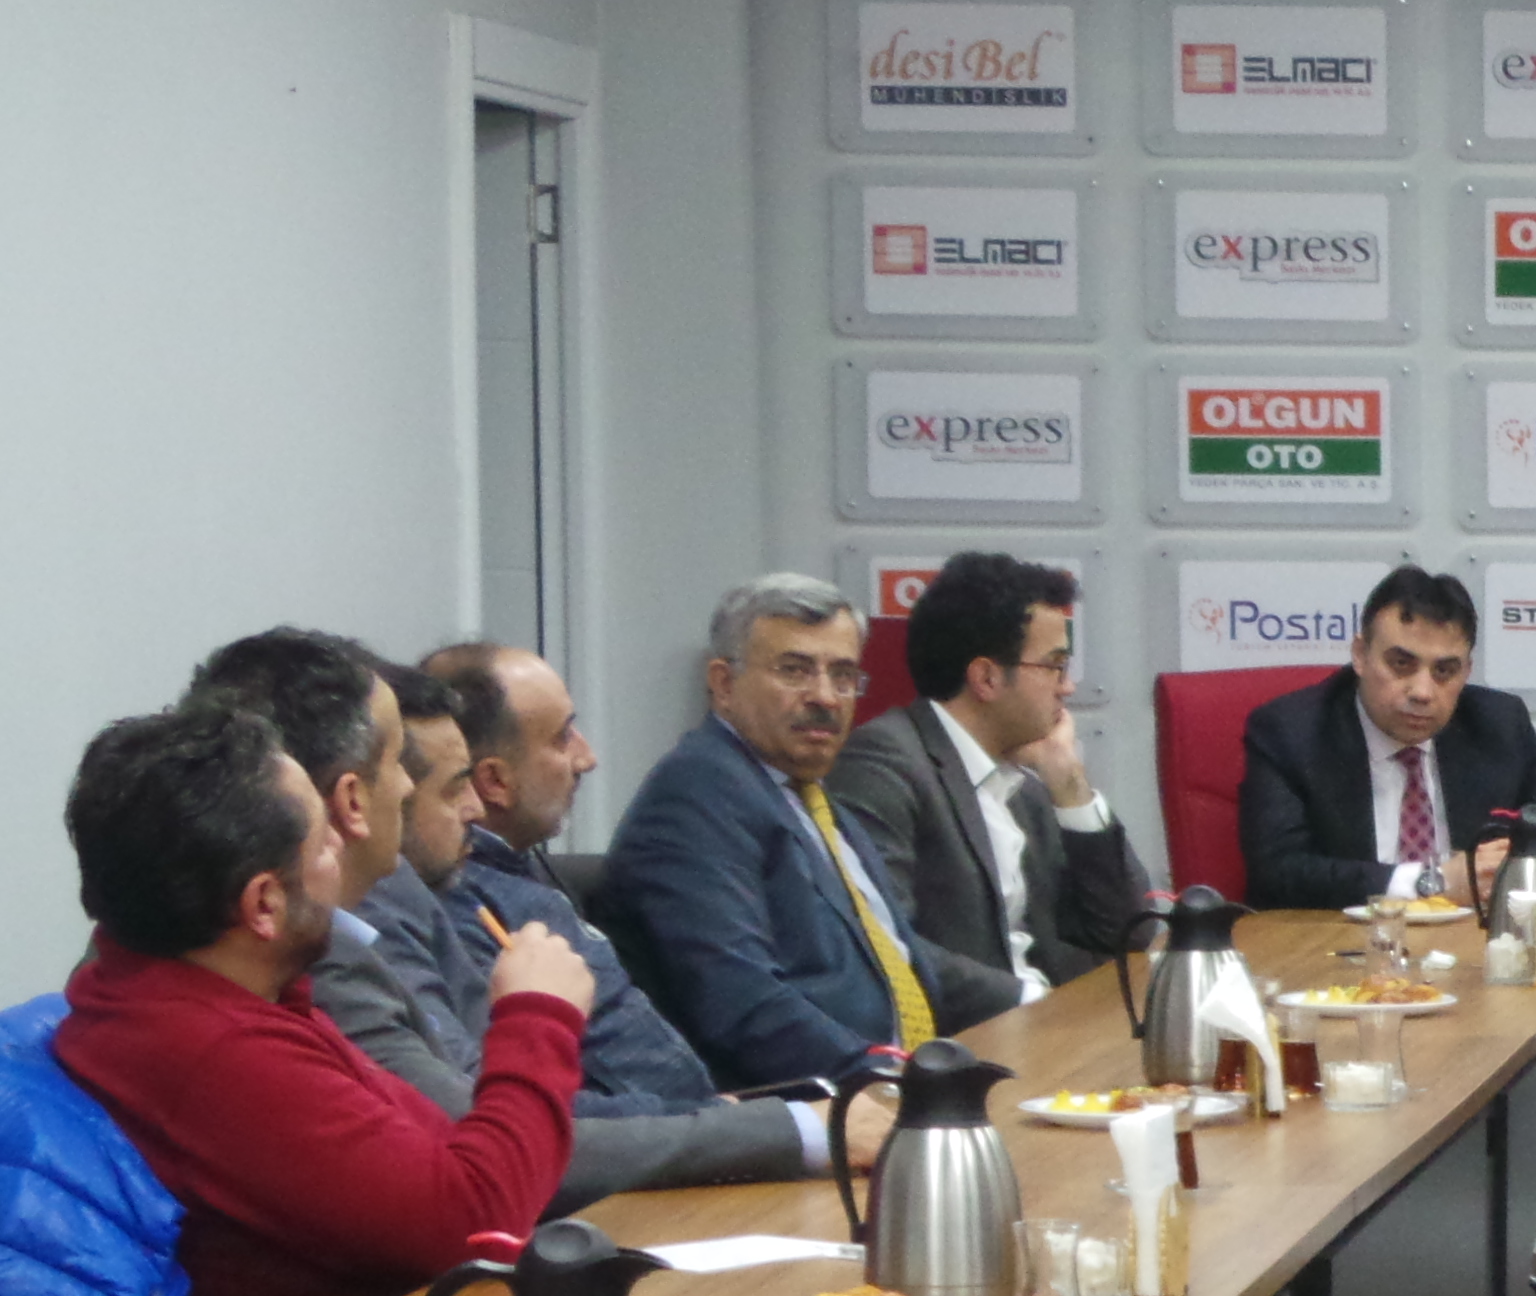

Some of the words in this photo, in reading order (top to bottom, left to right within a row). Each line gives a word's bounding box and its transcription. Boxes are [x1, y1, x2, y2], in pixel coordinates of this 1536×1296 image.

[1194, 234, 1370, 272] express
[1203, 396, 1365, 428] OLGUN
[886, 415, 1063, 452] express
[1247, 444, 1322, 469] OTO
[1230, 600, 1359, 640] Postal
